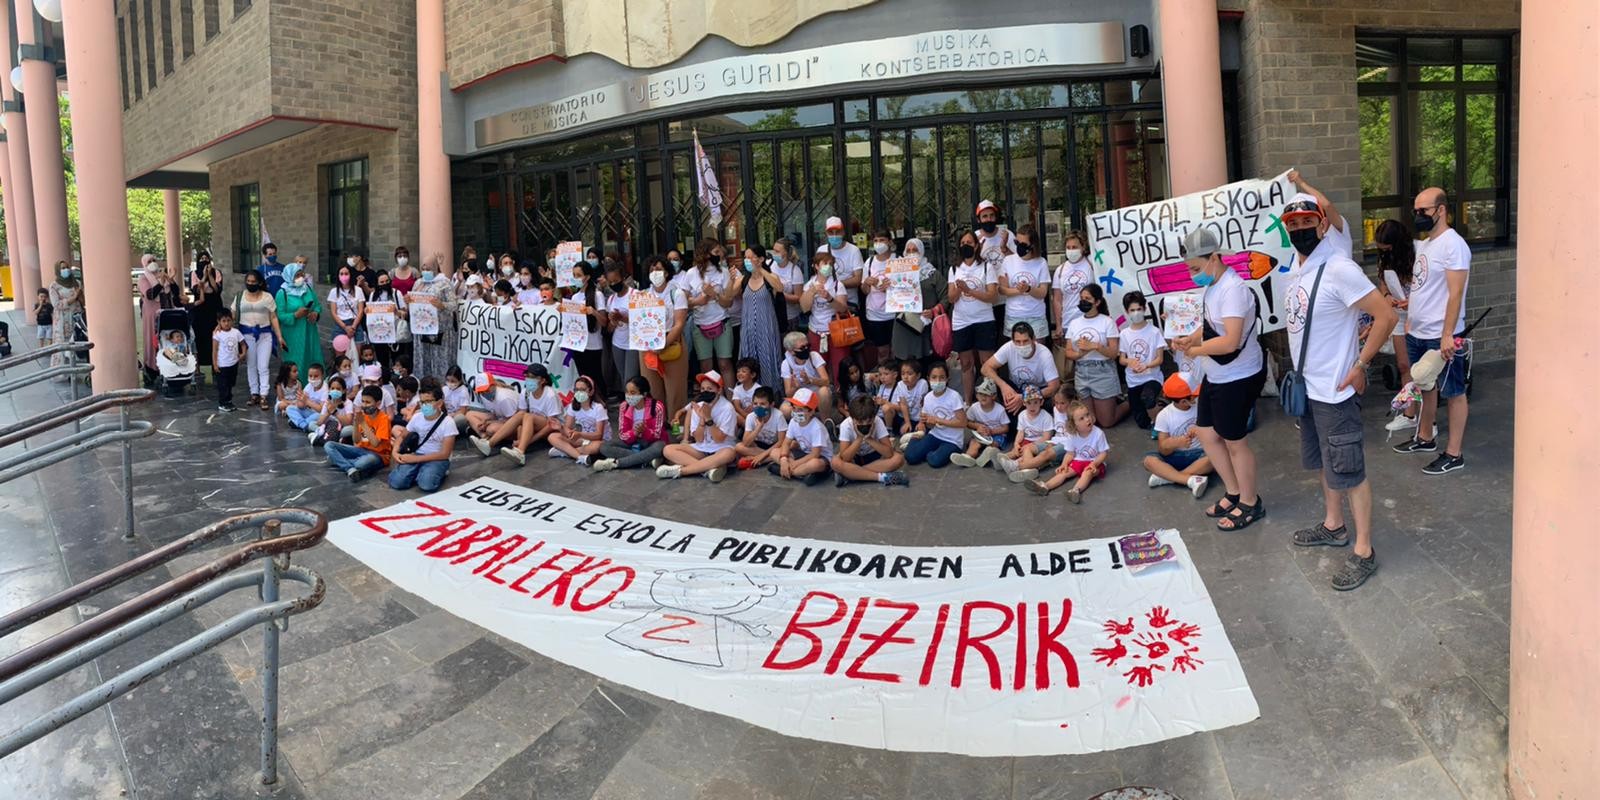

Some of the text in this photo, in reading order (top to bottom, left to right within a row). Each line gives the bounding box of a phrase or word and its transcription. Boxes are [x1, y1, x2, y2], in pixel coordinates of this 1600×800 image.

[916, 33, 992, 53] MUSIKA
[860, 49, 1049, 77] KONTSERBATORIOA
[511, 91, 606, 123] CONSERVATORIO
[522, 111, 588, 135] DE MUSICA
[1093, 181, 1285, 242] EUSKAL ESKOLA
[459, 484, 567, 523] EUSKAL
[575, 513, 696, 554] ESKOLA
[709, 537, 963, 579] PUBLIKOAREN
[999, 549, 1092, 578] ALDE
[358, 500, 1080, 691] ZABALEKO BIZIRIK
